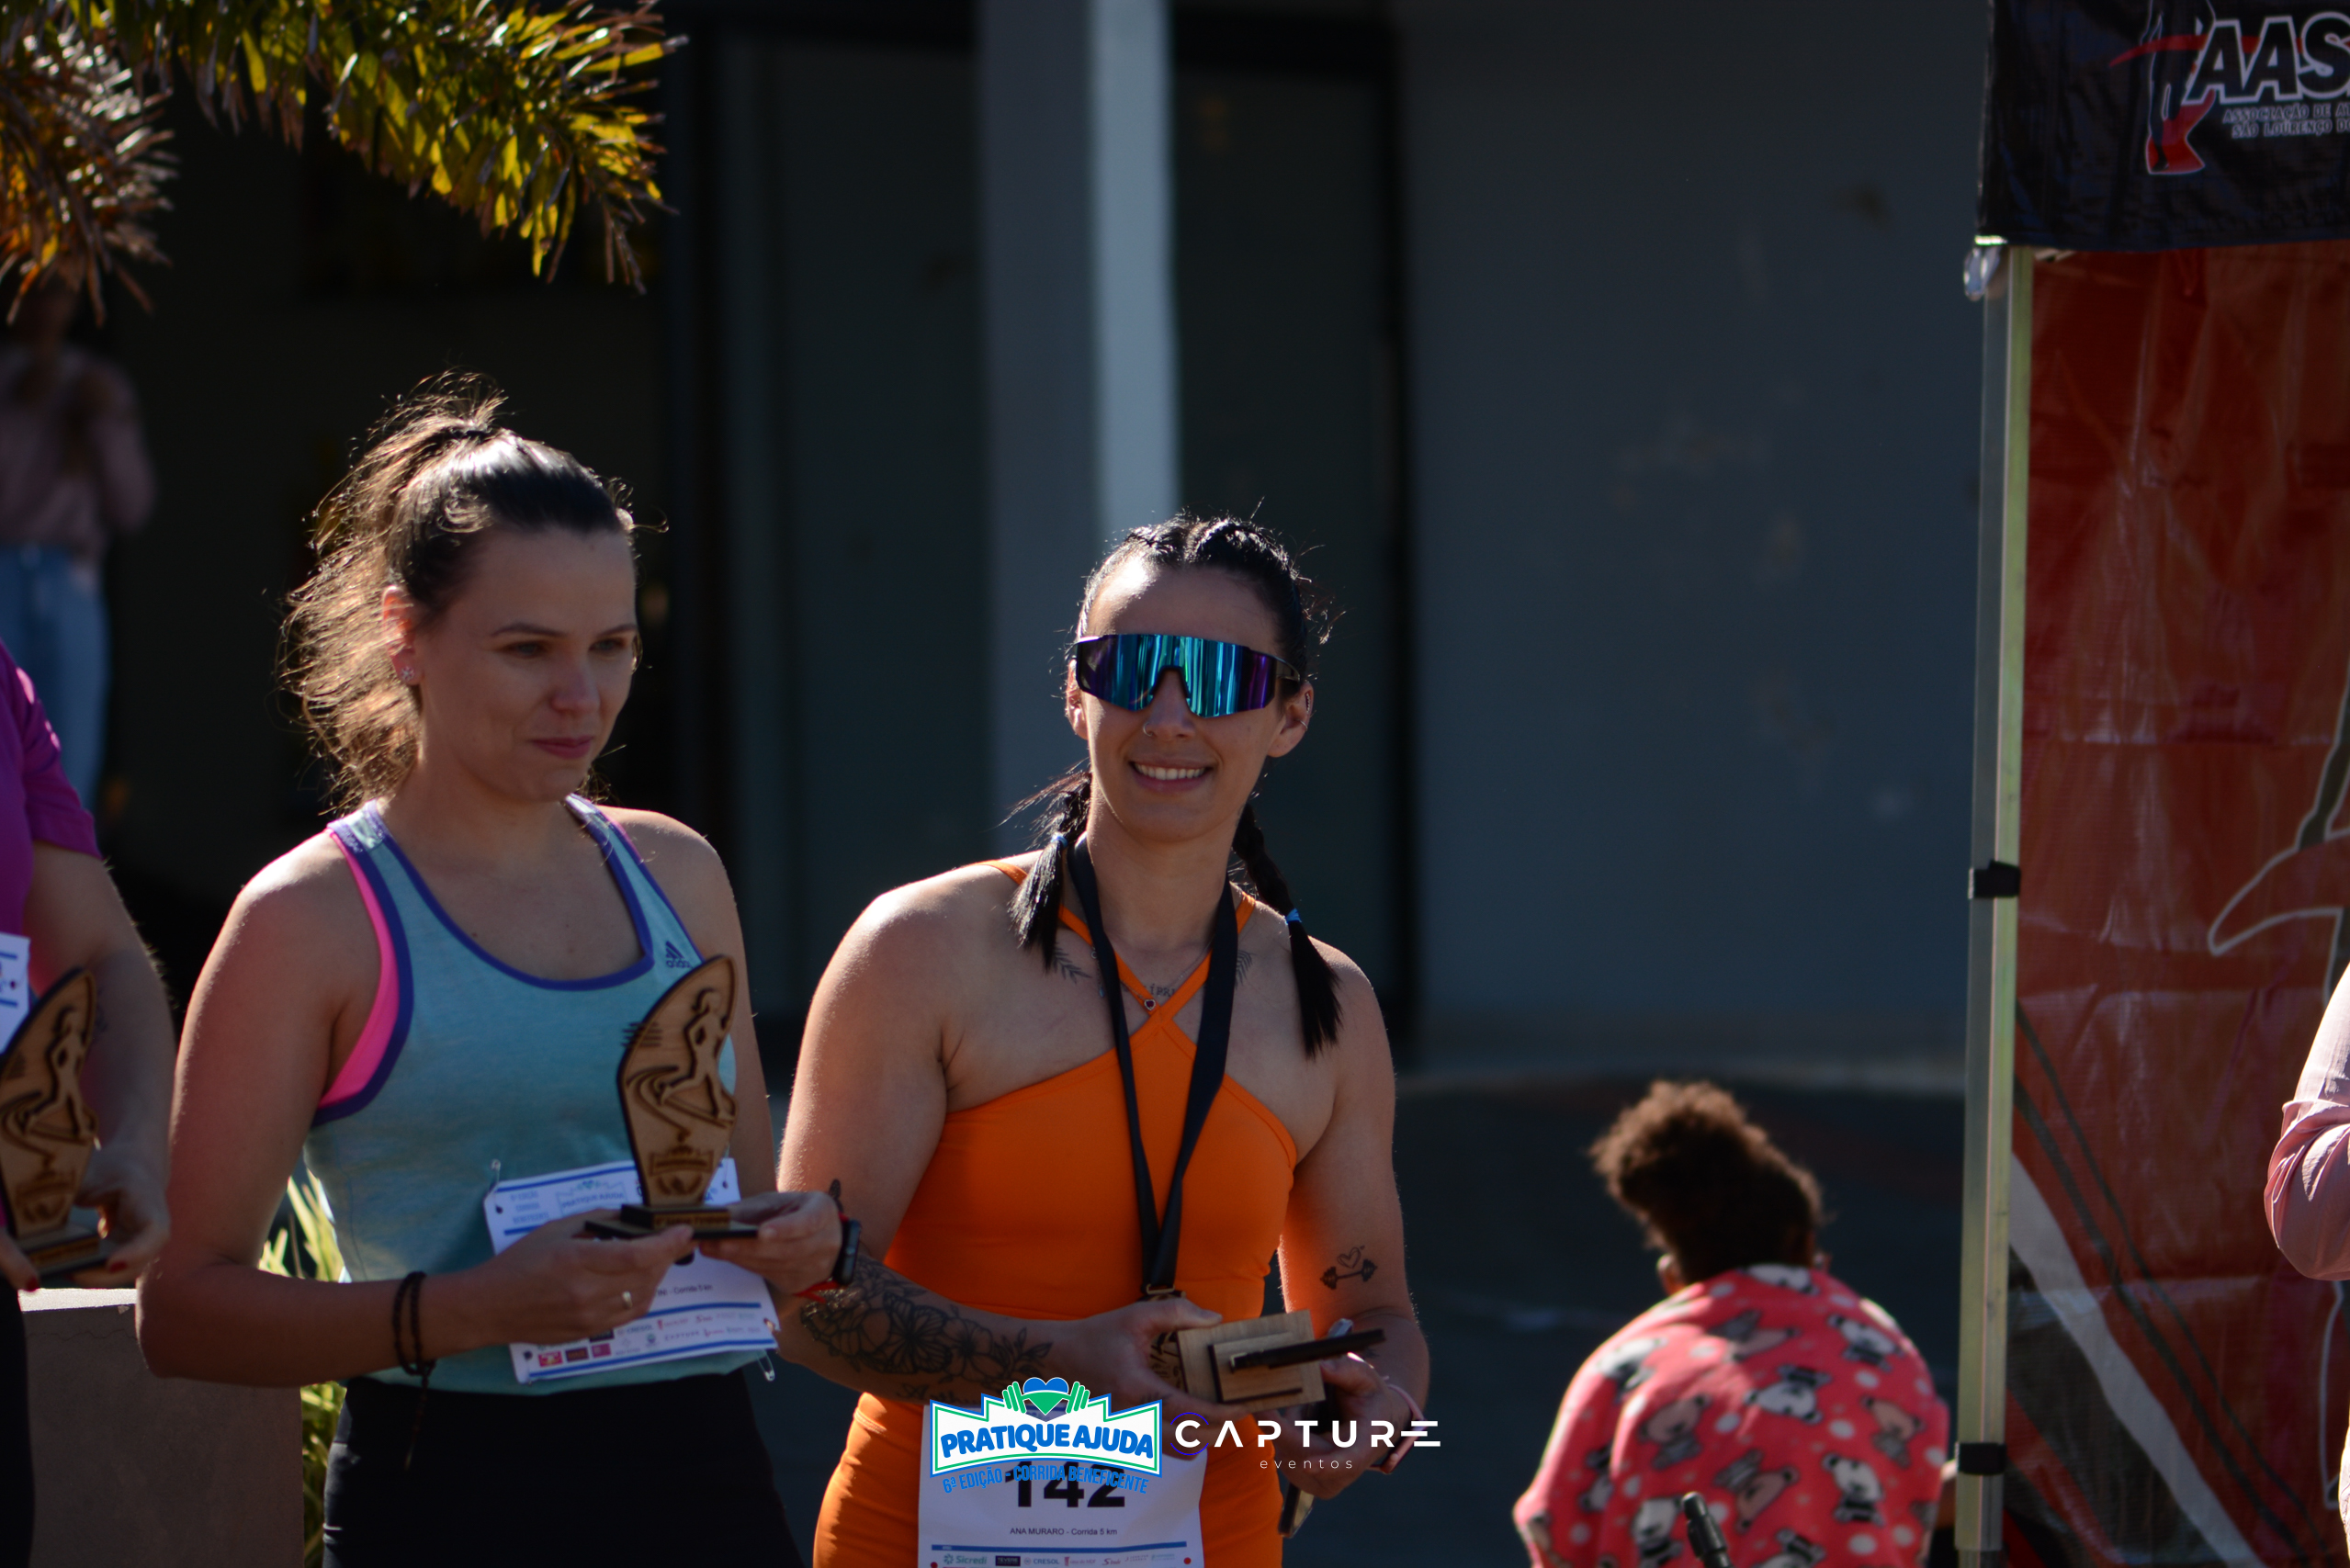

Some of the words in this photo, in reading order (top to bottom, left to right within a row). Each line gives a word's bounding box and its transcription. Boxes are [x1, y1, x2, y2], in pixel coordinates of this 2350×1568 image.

[2181, 11, 2350, 104] AAS
[2222, 103, 2310, 124] ASSOCIAÇÃO
[2313, 103, 2332, 119] DE
[2231, 120, 2259, 139] SÃO
[2264, 118, 2333, 138] LOURENÇO
[1005, 1461, 1125, 1507] 142
[955, 1555, 987, 1564] Sicredi
